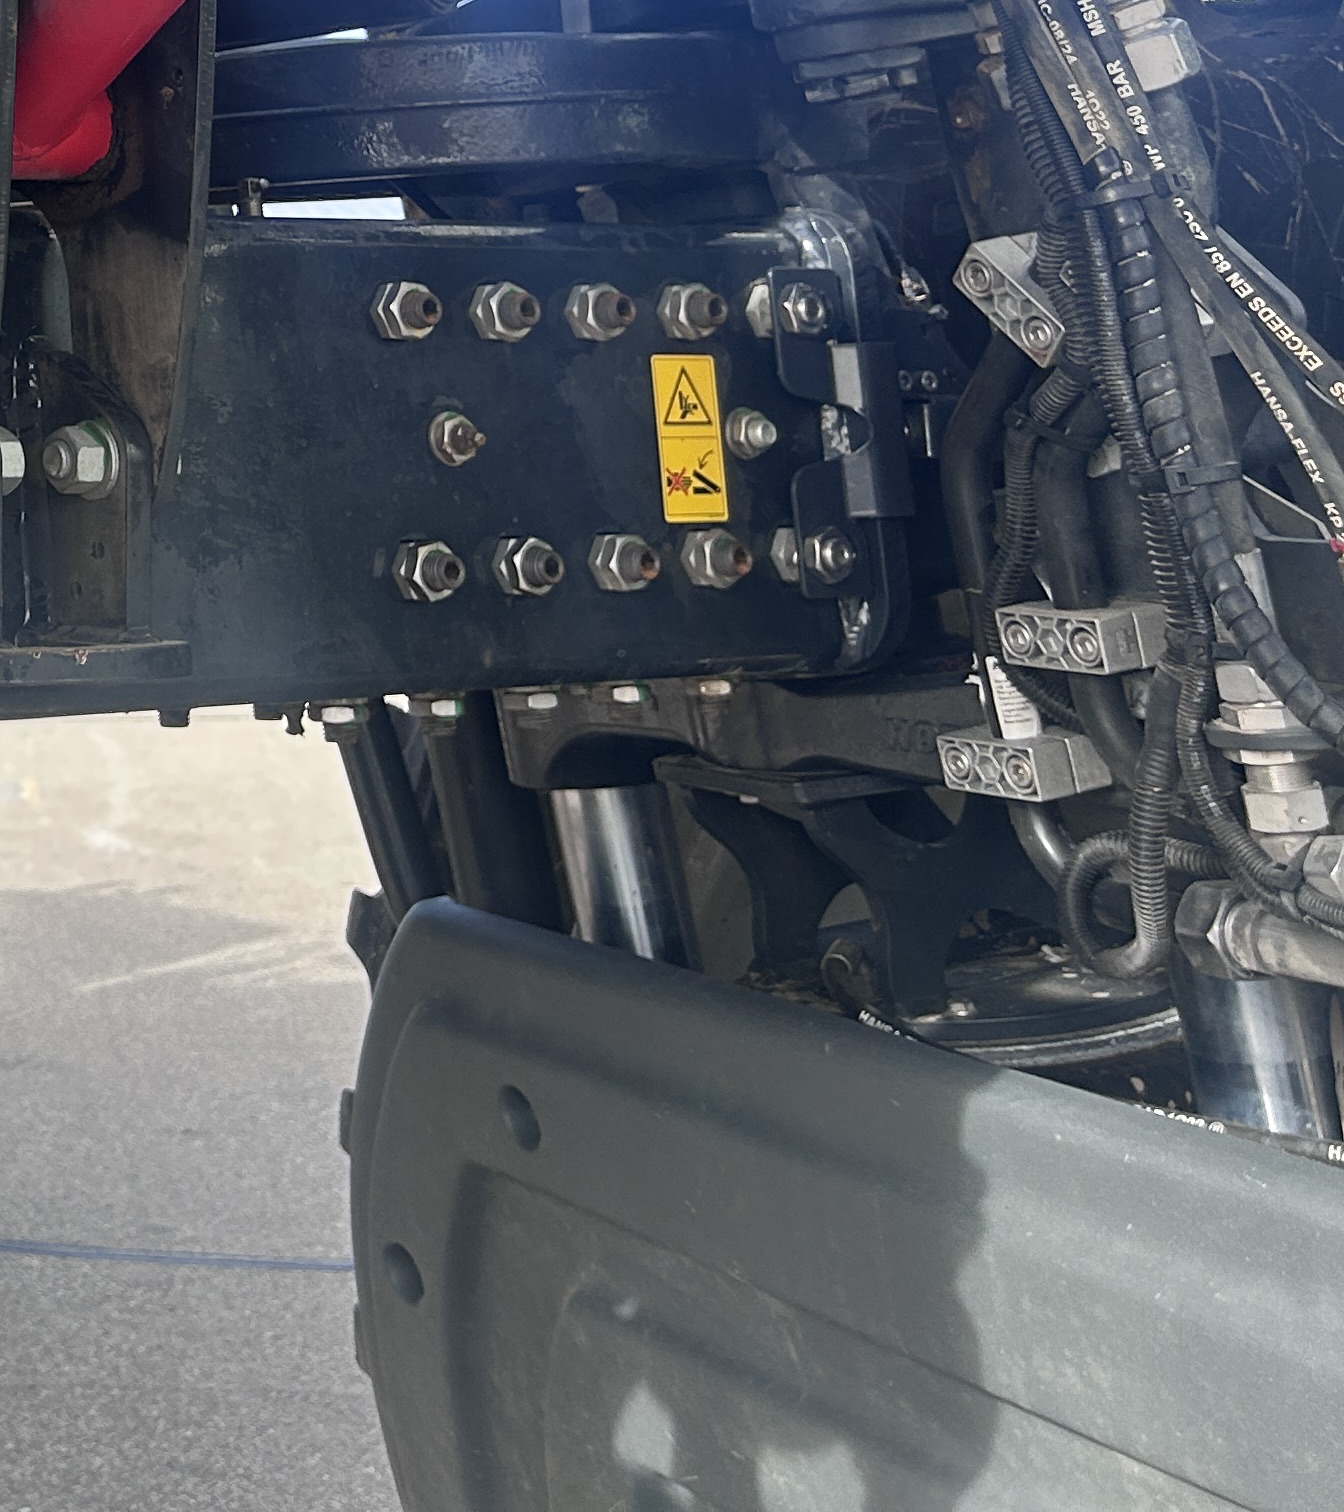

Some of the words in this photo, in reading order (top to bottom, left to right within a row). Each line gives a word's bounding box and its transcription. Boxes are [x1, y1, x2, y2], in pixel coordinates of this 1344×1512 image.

[1106, 58, 1135, 99] BAR
[1124, 104, 1150, 136] 450
[1224, 271, 1255, 300] EN
[1247, 295, 1324, 373] EXCEEDS
[1249, 370, 1325, 485] HANSA-FLEX
[1323, 501, 1343, 529] KP
